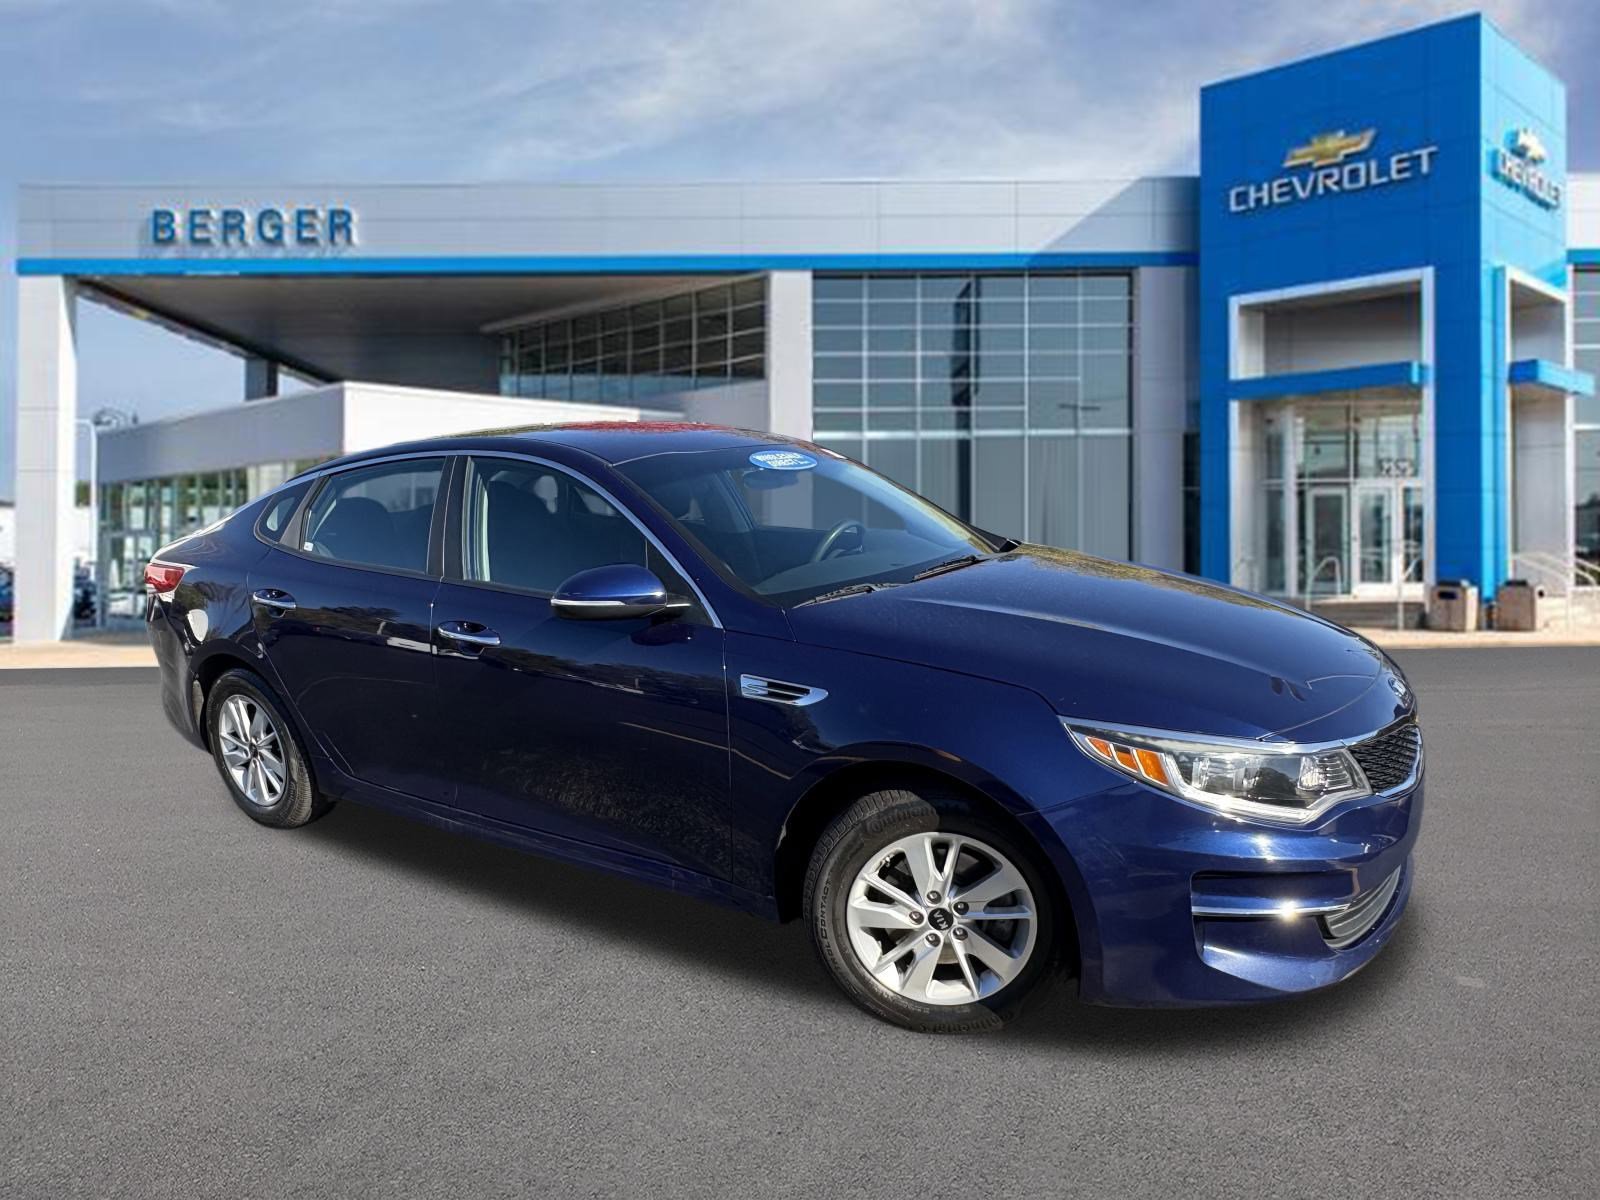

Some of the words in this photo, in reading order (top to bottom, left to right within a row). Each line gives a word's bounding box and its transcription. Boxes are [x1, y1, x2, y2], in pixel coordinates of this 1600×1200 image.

[1229, 146, 1438, 212] CHEVROLET
[153, 208, 355, 245] BERGER
[933, 910, 949, 930] KIA
